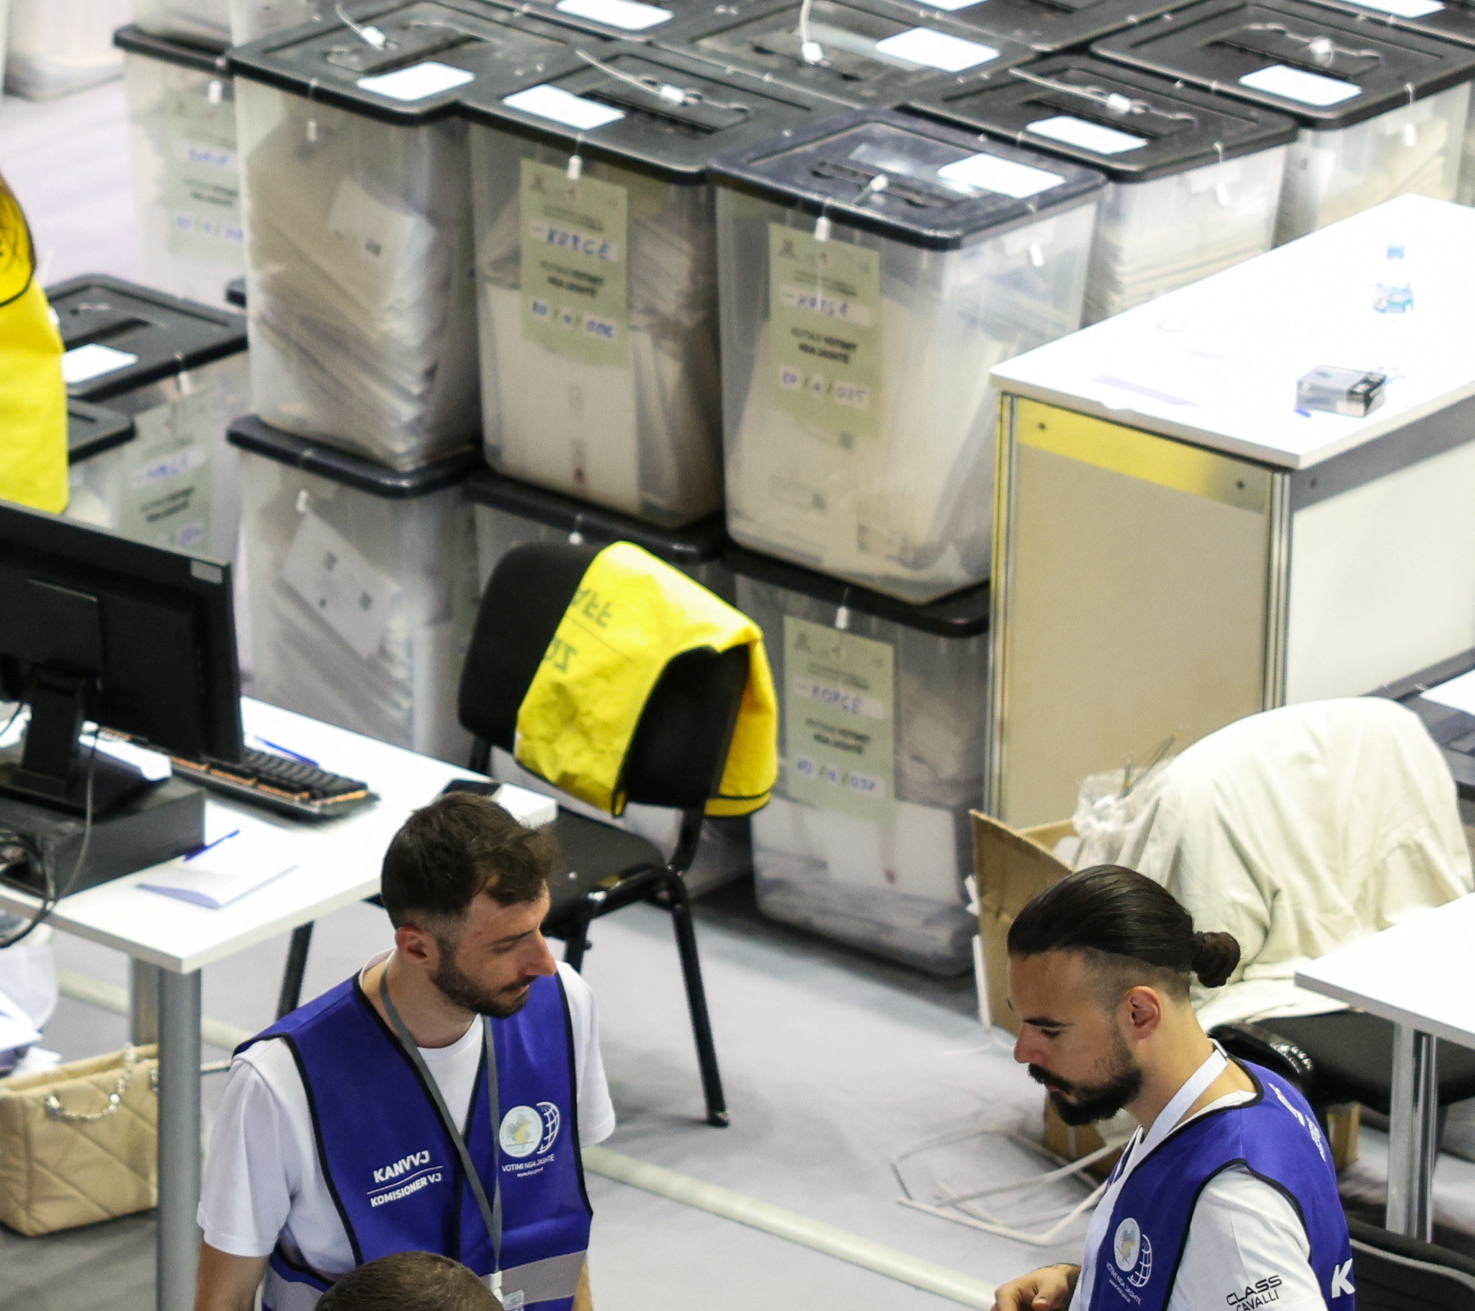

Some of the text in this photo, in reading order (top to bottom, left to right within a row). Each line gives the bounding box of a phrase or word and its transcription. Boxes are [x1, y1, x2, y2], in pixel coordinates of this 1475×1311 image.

[373, 1149, 431, 1183] KANVVJ
[502, 1161, 525, 1173] VOTIMI
[370, 1172, 442, 1208] KOMISIONER VJ
[1225, 1274, 1283, 1306] CLASS
